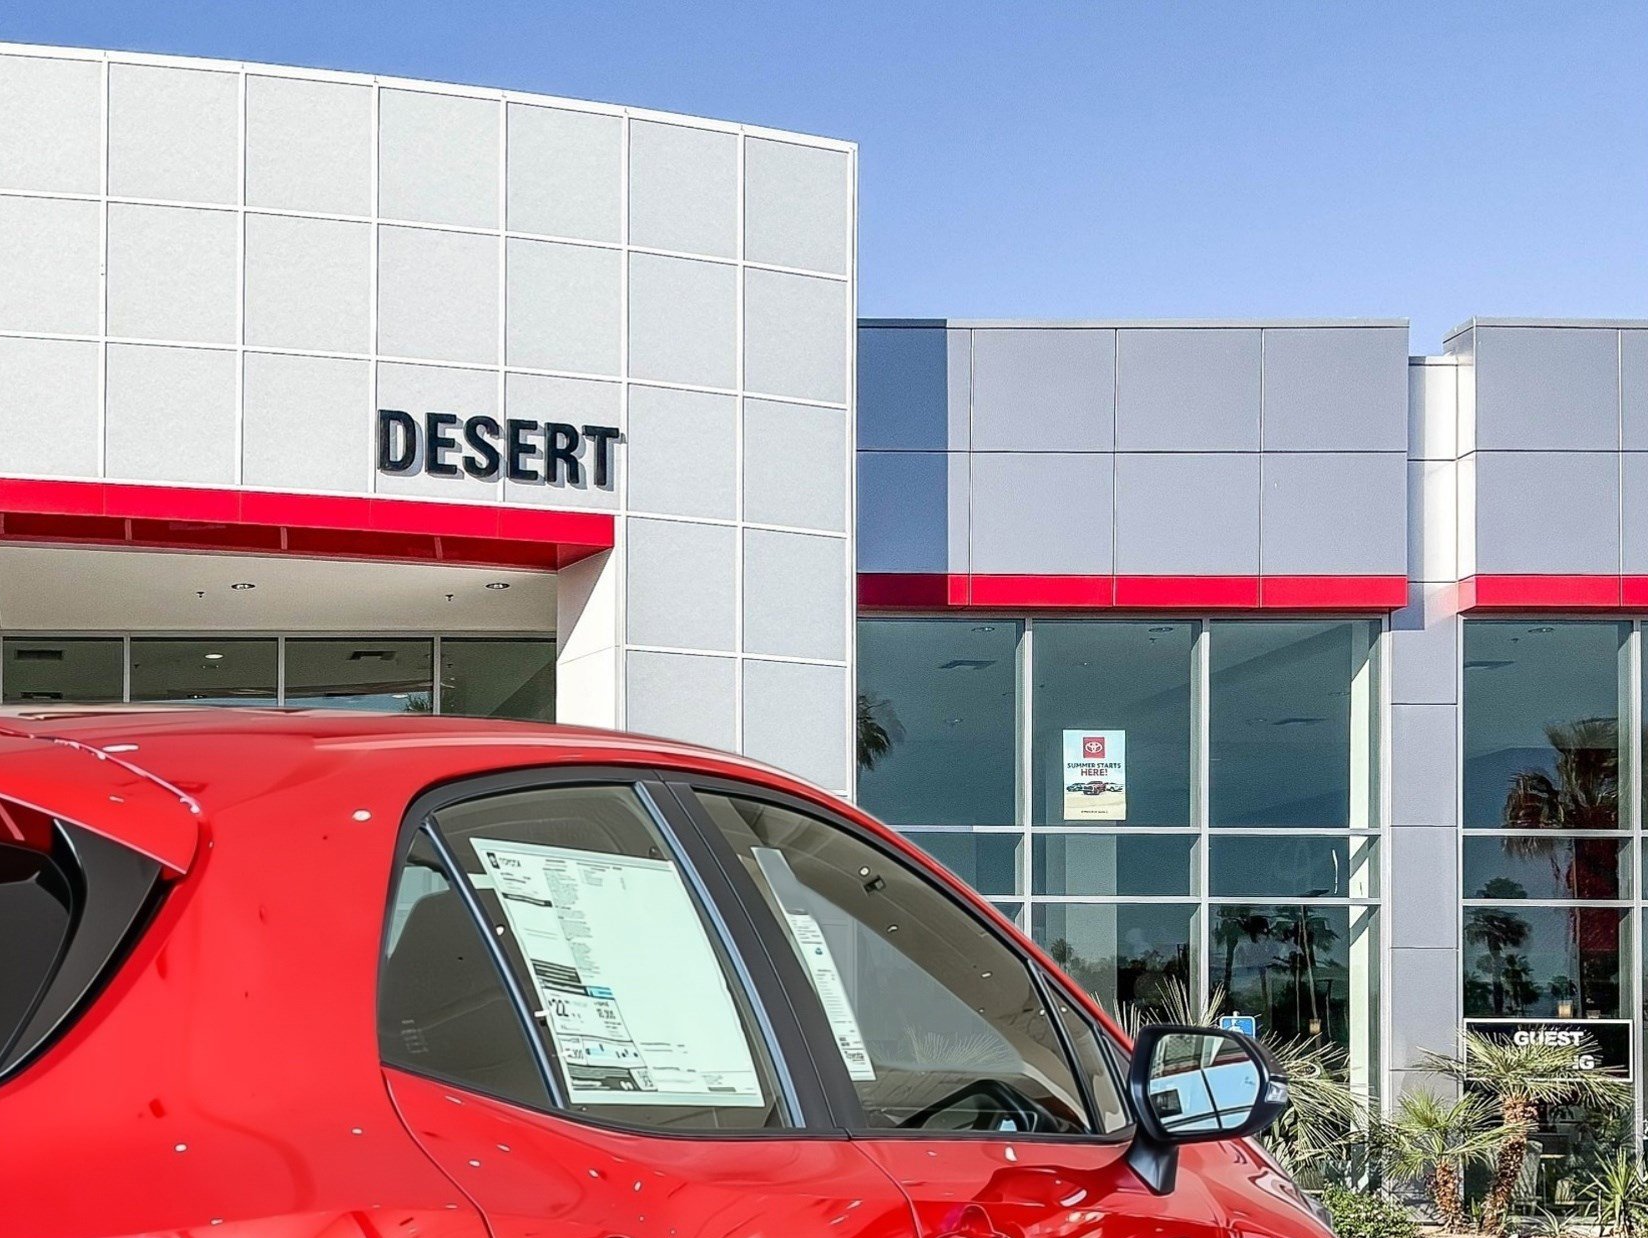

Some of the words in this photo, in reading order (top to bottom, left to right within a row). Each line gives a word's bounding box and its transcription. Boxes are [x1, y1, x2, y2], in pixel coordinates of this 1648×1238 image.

[377, 409, 620, 487] DESERT
[1080, 768, 1108, 777] HERE!
[1513, 1030, 1584, 1047] GUEST
